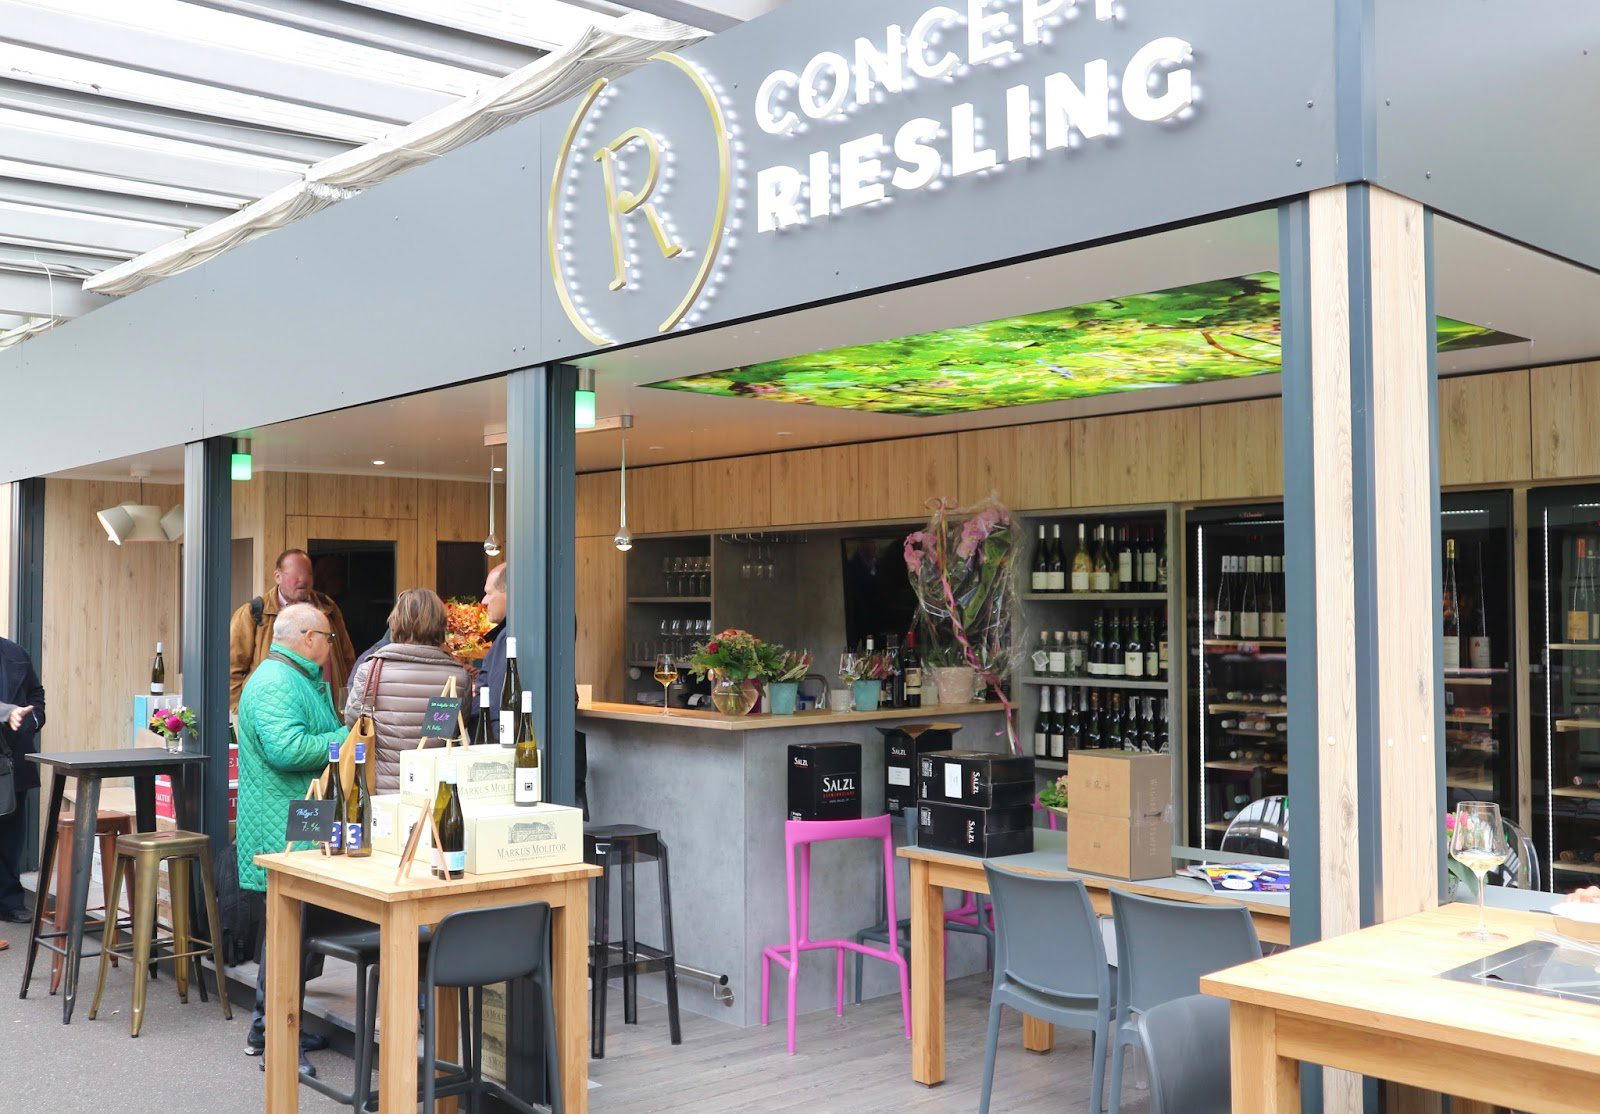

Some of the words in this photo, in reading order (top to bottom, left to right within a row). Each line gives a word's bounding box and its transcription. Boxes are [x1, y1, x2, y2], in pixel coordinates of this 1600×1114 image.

[757, 37, 1194, 233] RIESLING
[594, 126, 683, 291] R
[822, 777, 855, 792] SALZL
[972, 771, 981, 795] SALZL
[967, 820, 976, 844] SALZL
[496, 846, 531, 860] MARKUS
[532, 843, 567, 856] MOLITOR
